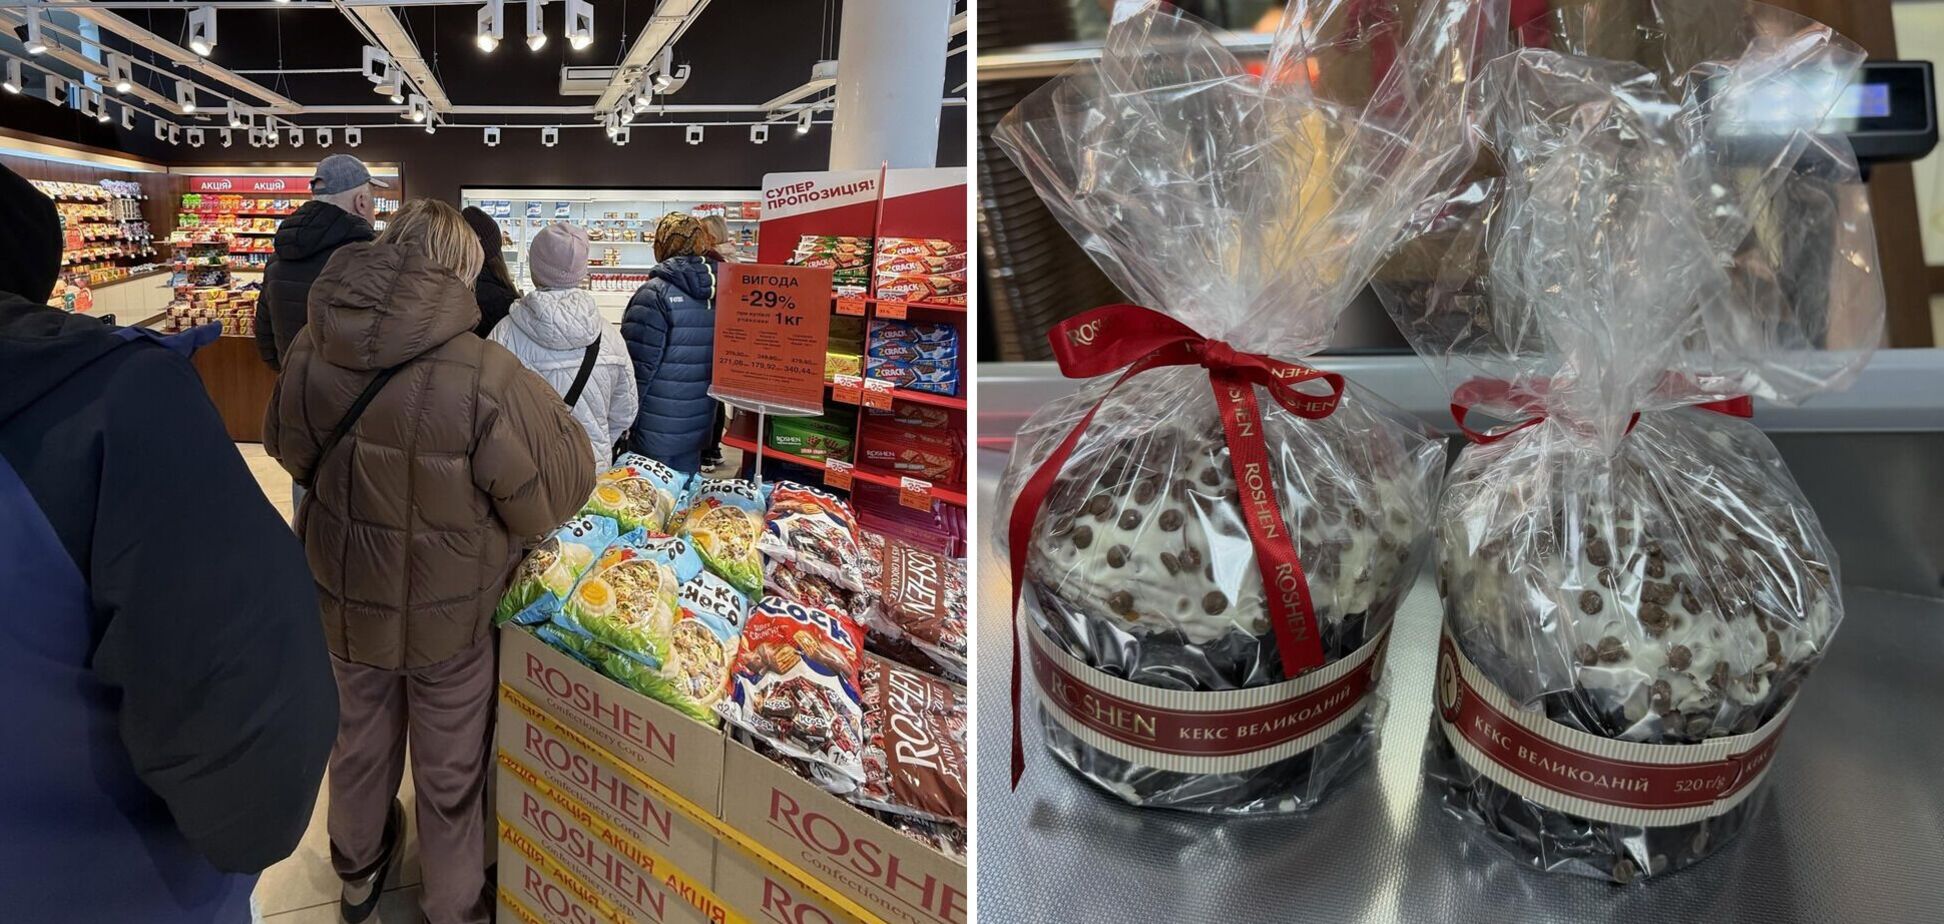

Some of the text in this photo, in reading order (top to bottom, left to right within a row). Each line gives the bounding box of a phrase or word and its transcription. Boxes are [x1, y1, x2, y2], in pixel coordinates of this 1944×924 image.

[201, 181, 229, 190] АКЦІЯ
[254, 181, 281, 190] АКЦІЯ
[766, 181, 815, 199] СУПЕР
[767, 180, 875, 210] ПРОПОЗИЦІЯ!
[742, 275, 799, 287] ВИГОДА
[881, 368, 905, 376] CRACK
[625, 459, 669, 485] CHOCO
[1245, 462, 1280, 540] ROSHEN
[679, 582, 738, 626] HOCO
[1275, 562, 1310, 643] ROSHEN
[526, 652, 676, 763] ROSHEN
[546, 697, 615, 745] Confectionery
[888, 669, 939, 770] ROSHEN
[1051, 671, 1156, 738] ROSHEN
[1179, 686, 1352, 741] КЕКС ВЕЛИКОДНІЙ
[525, 722, 672, 842] ROSHEN
[1474, 714, 1512, 751] КЕКС
[1517, 745, 1649, 793] ВЕЛИКОДНІЙ
[1674, 779, 1703, 793] 520
[544, 770, 612, 826] Confectionery
[503, 829, 601, 911] АКЦІЯ АКЦІЯ
[523, 792, 665, 922] ROSHEN
[541, 838, 607, 895] Confectionery
[547, 788, 592, 828] АКЦІЯ
[602, 828, 654, 874] АКЦІЯ
[665, 874, 727, 924] АКЦІЯ
[524, 865, 598, 924] ROS
